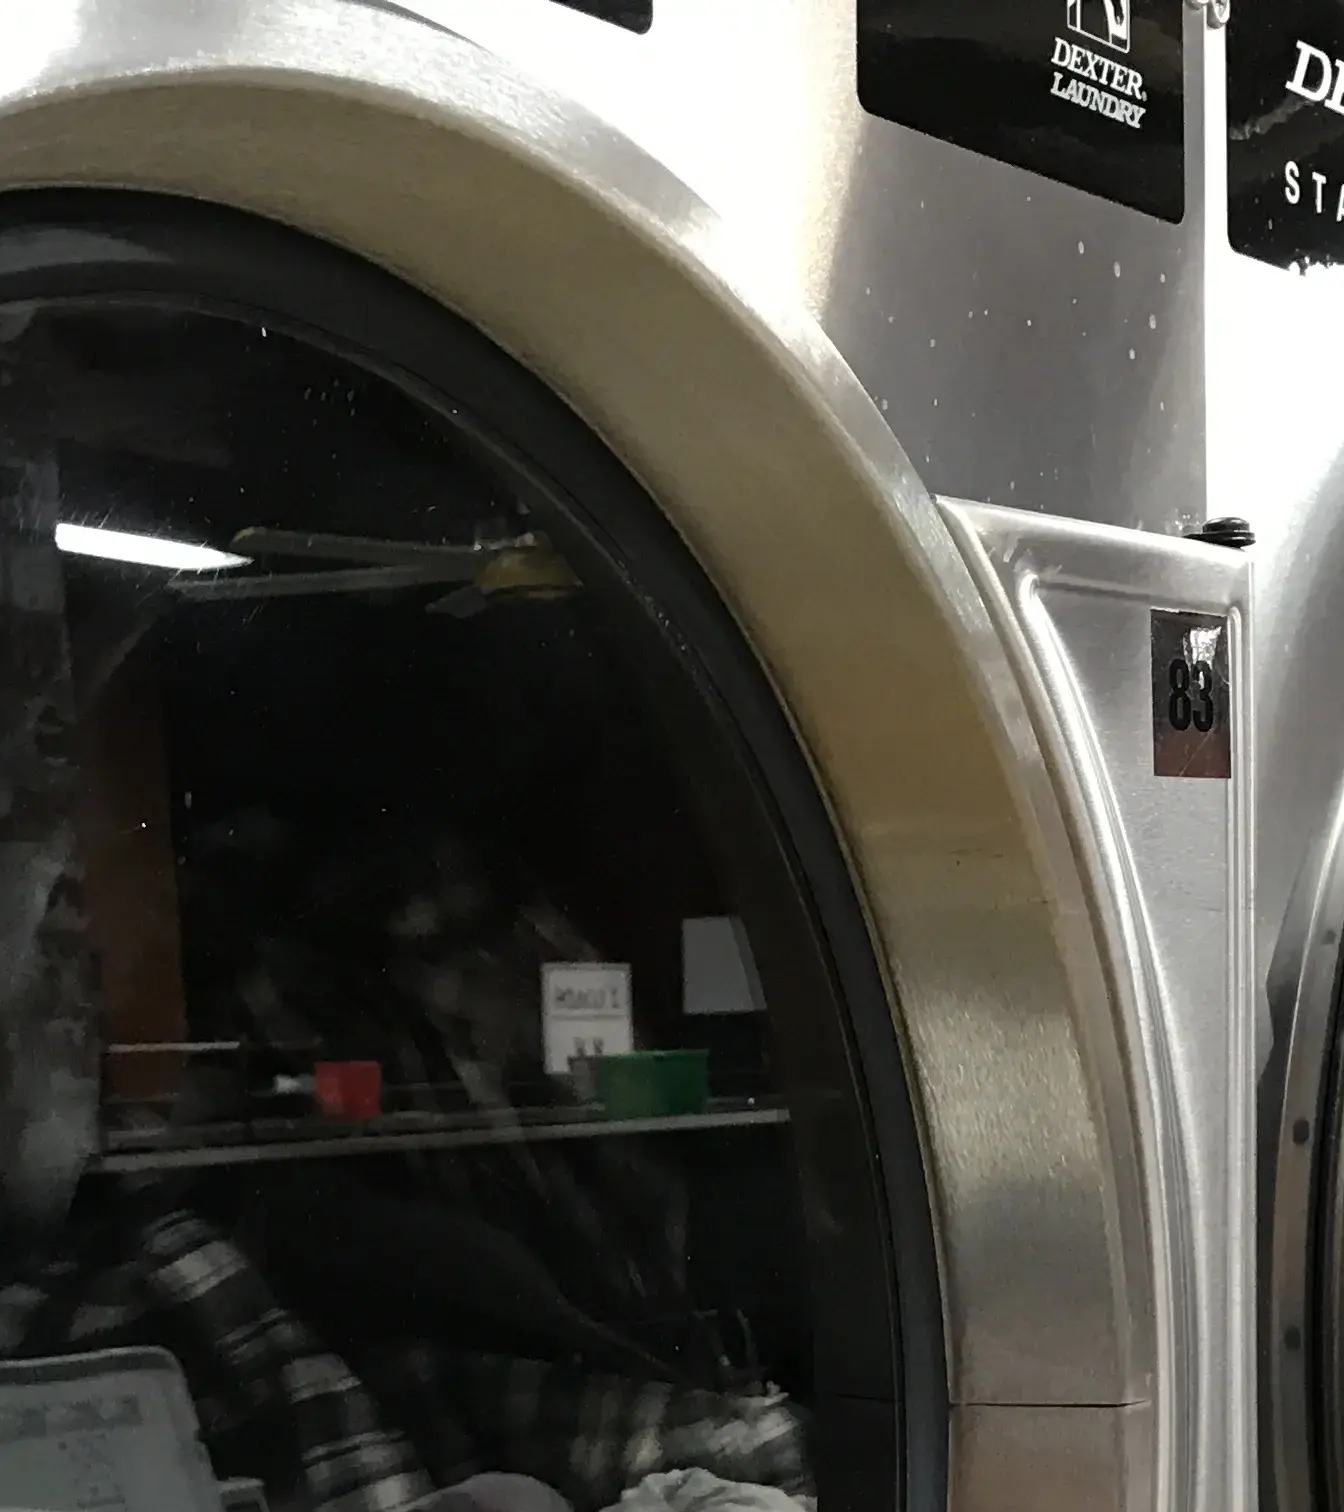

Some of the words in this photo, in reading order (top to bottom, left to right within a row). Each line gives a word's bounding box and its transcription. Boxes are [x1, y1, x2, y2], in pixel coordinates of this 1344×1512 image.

[1050, 72, 1146, 128] LAUNDRY
[1051, 36, 1144, 100] DEXTER
[1168, 657, 1214, 733] 83
